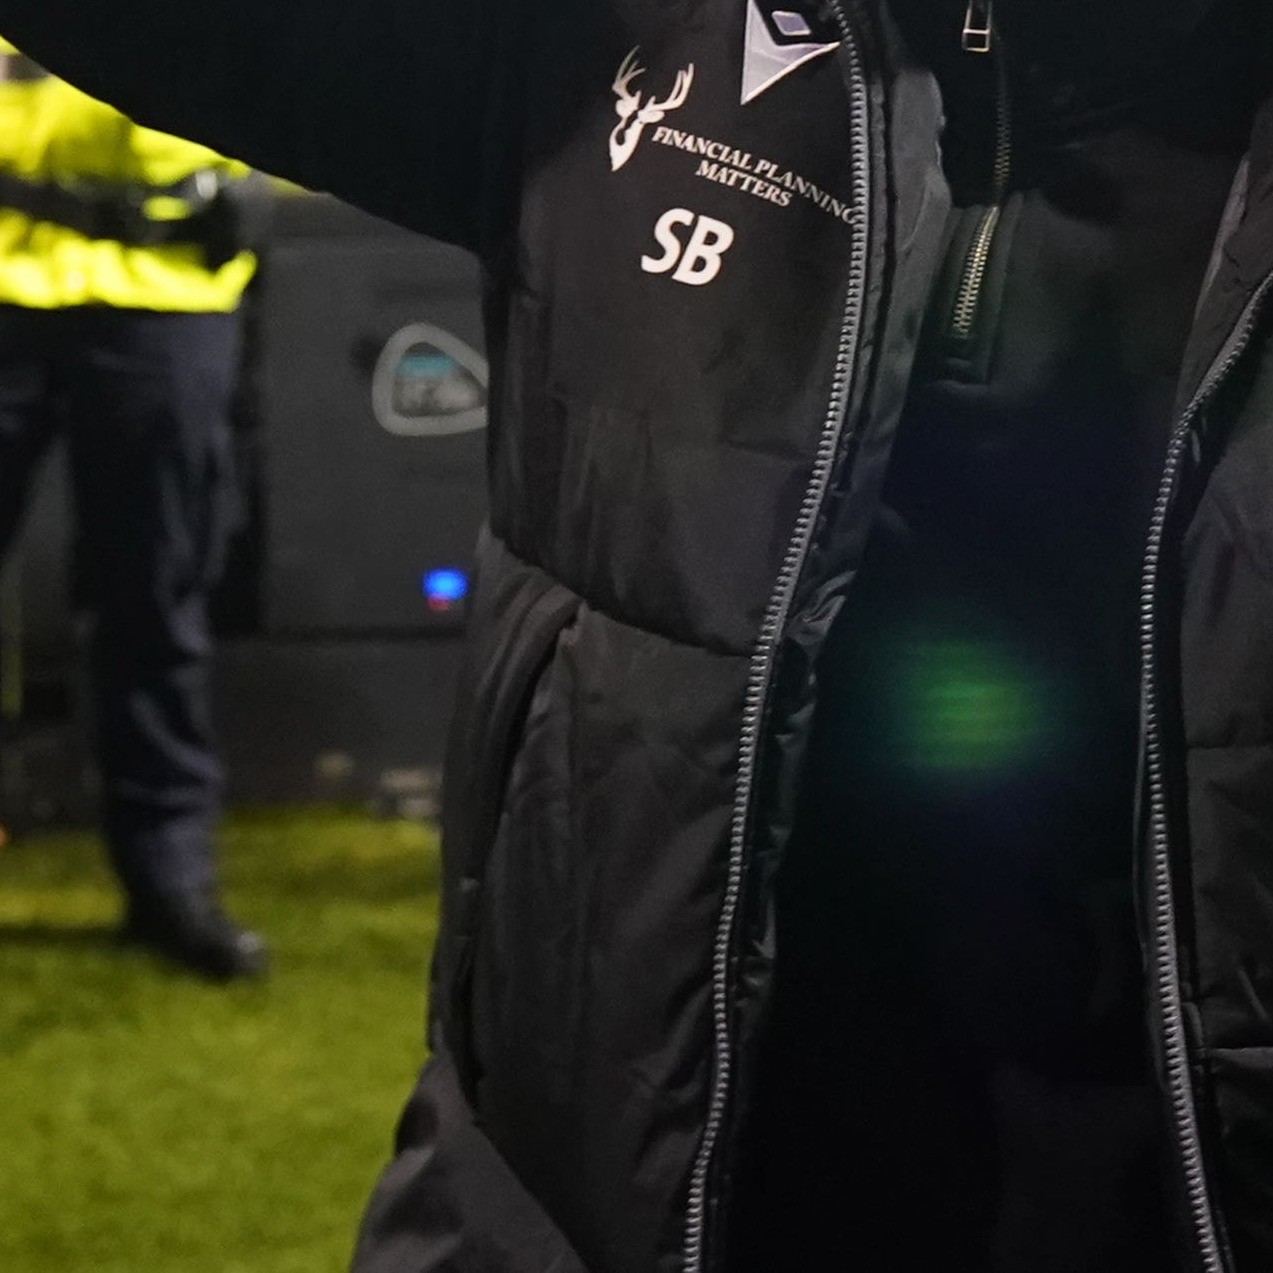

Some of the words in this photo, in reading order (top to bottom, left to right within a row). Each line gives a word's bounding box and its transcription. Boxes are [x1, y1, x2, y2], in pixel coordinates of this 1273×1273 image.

[652, 126, 754, 172] FINANCIAL
[695, 159, 793, 208] MATTERS
[640, 207, 735, 286] SB
